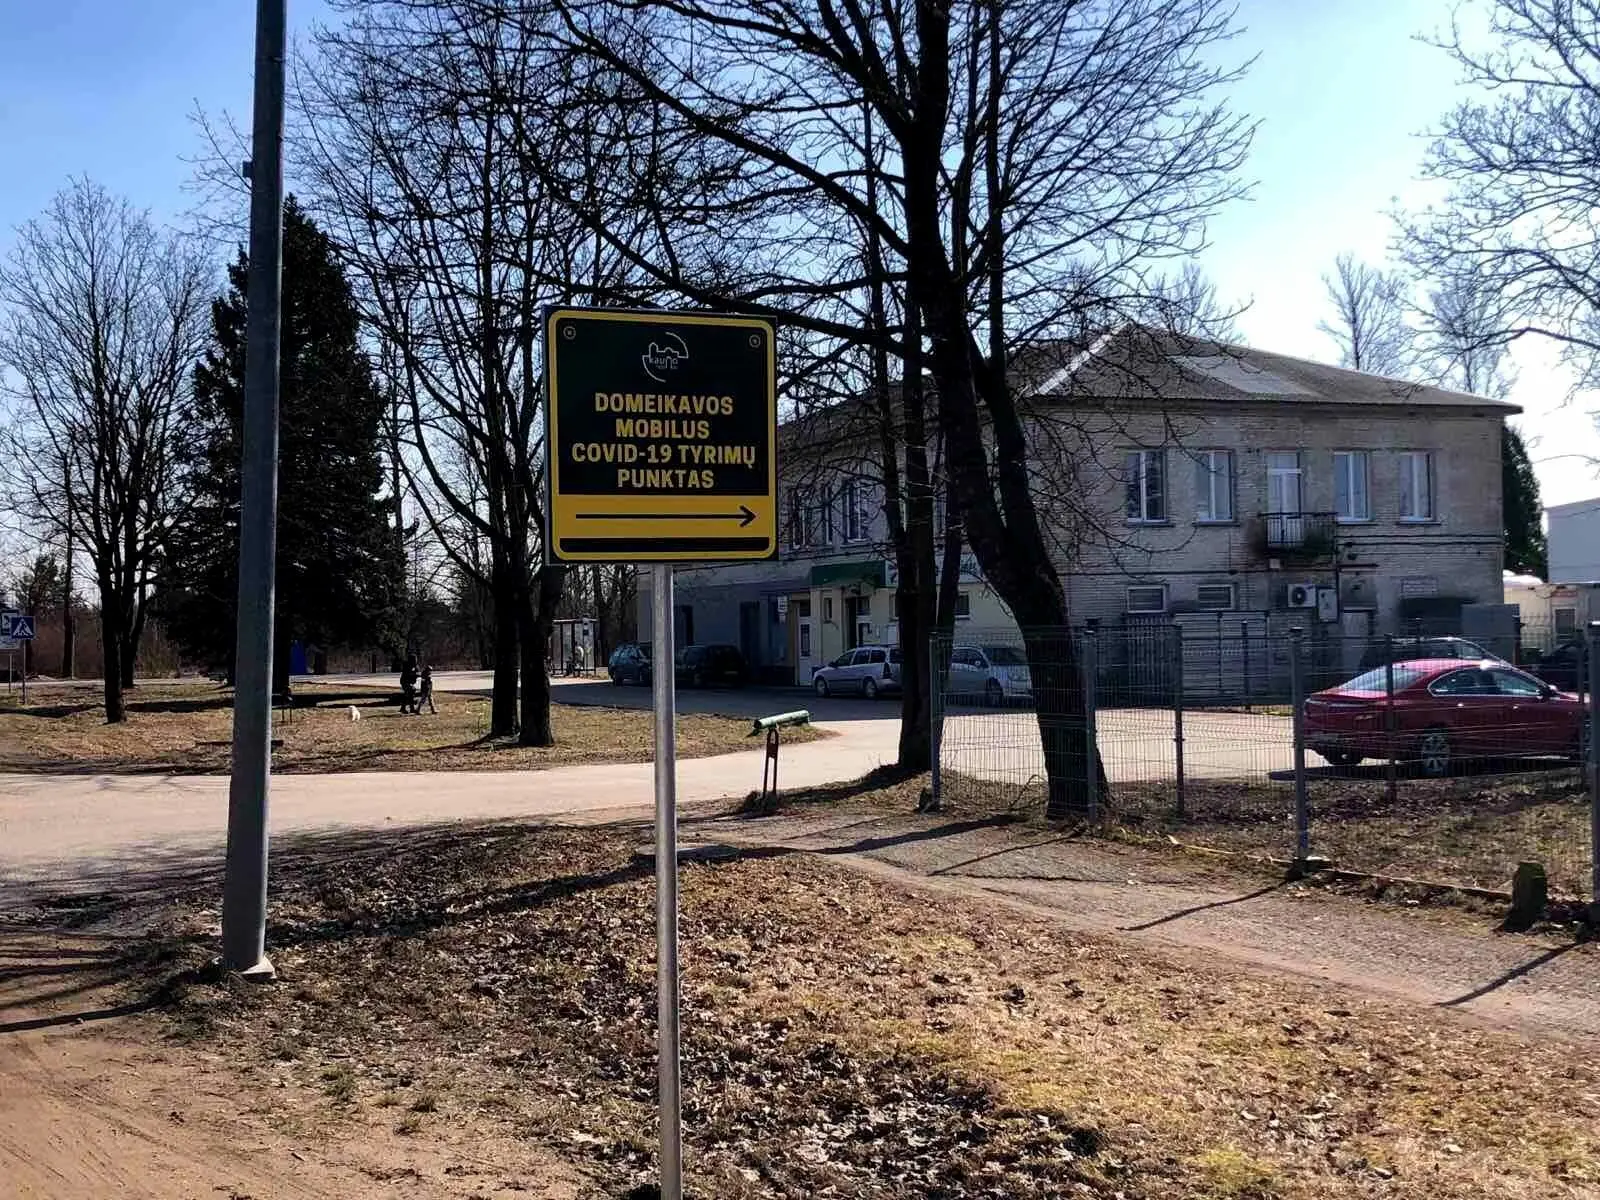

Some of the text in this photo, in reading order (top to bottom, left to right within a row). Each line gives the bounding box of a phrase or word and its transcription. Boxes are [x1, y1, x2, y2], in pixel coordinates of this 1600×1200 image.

[595, 392, 733, 415] DOMEIKAVOS
[616, 418, 710, 439] MOBILUS
[572, 443, 755, 468] COVID-19 TYRIMŲ
[617, 469, 714, 489] PUNKTAS
